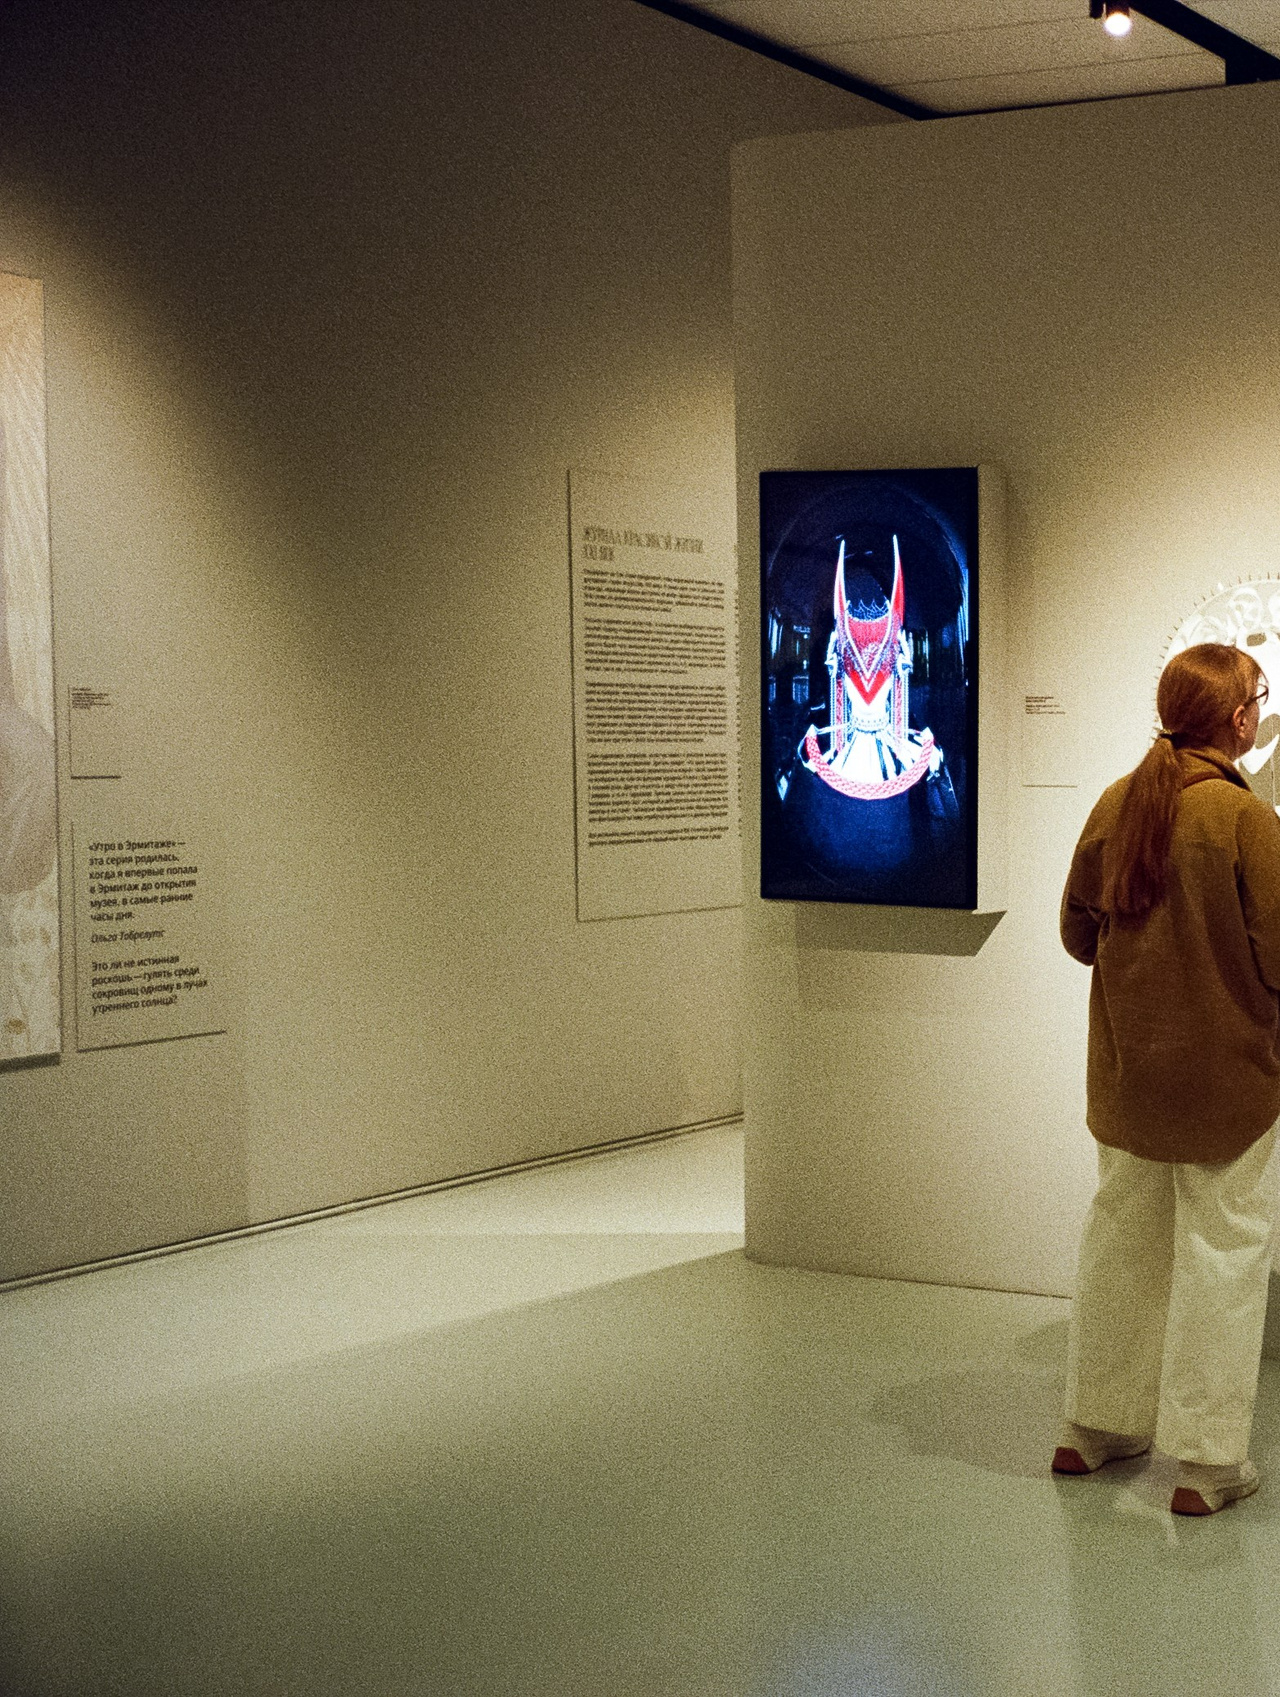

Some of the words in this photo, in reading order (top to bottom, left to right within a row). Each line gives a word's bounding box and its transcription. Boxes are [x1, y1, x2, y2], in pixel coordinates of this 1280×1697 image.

[89, 841, 116, 853] «Утро
[117, 842, 124, 850] в
[125, 839, 176, 852] Эрмитаже»
[89, 858, 104, 866] эта
[105, 856, 133, 867] серия
[89, 871, 115, 880] когда
[117, 870, 123, 878] я
[124, 868, 165, 879] впервые
[166, 866, 198, 875] попала
[98, 883, 139, 896] Эрмитаж
[141, 882, 153, 892] до
[154, 879, 197, 891] открытия
[129, 896, 159, 905] самые
[160, 893, 194, 905] ранние
[90, 913, 114, 922] часы
[91, 933, 117, 943] Ольга
[91, 961, 108, 971] Это
[109, 961, 122, 970] ли
[124, 960, 135, 968] не
[137, 955, 180, 967] истинная
[91, 974, 133, 988] роскошь
[143, 969, 172, 982] гулять
[174, 967, 200, 979] среди
[91, 987, 139, 1000] сокровищ
[140, 983, 175, 995] одному
[176, 982, 182, 990] в
[183, 979, 208, 991] лучах
[91, 1001, 140, 1016] утреннего
[141, 994, 178, 1008] солнца?
